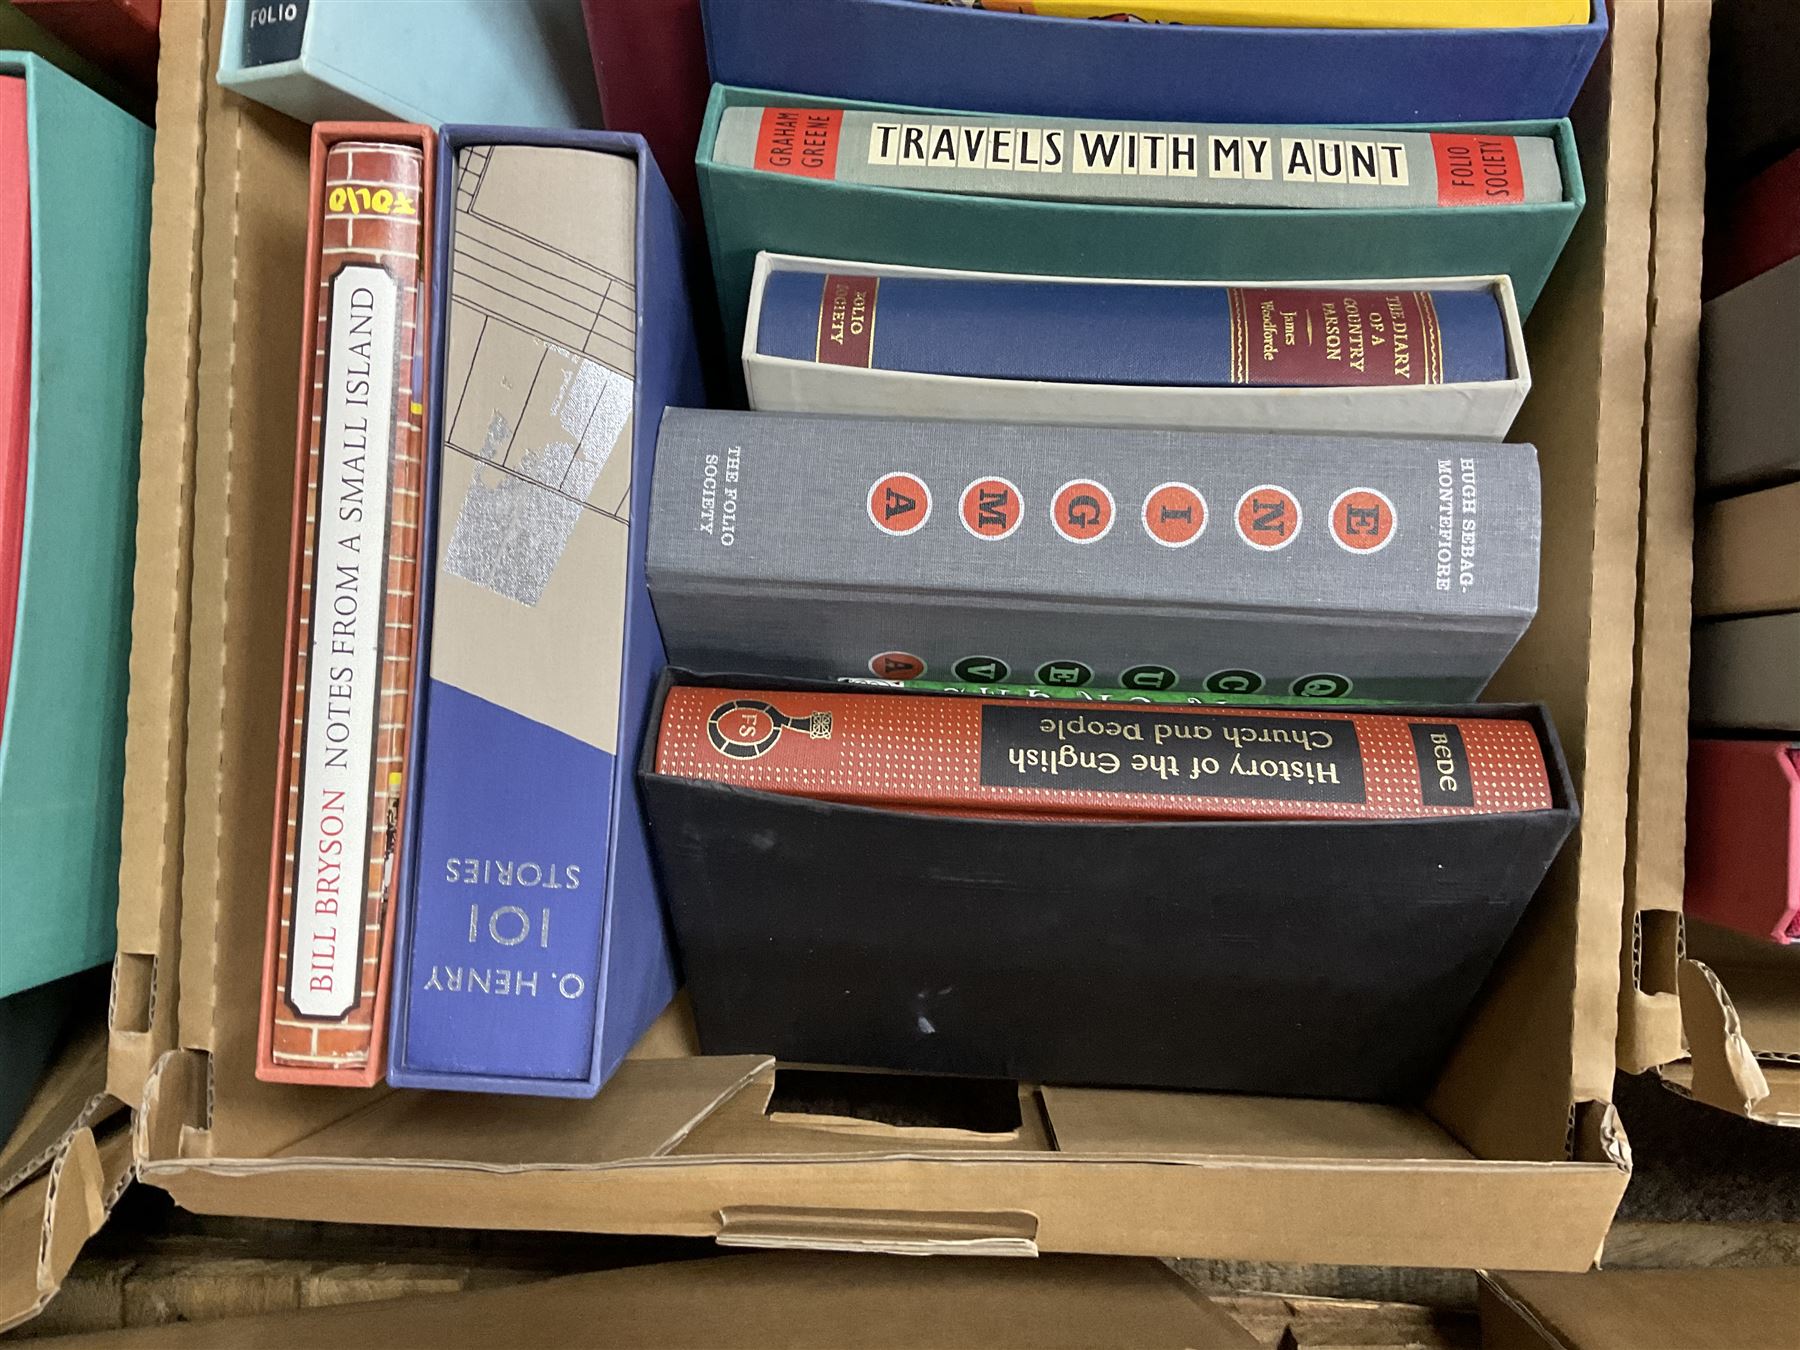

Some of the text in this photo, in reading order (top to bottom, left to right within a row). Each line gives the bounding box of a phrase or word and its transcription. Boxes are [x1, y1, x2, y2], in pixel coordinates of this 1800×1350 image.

[251, 4, 298, 28] FOLIO
[769, 112, 799, 167] GRAHAM
[801, 115, 830, 168] GREENE
[876, 126, 1403, 178] TRAVELS WITH MY AUNT
[1447, 146, 1475, 187] FOLIO
[1478, 141, 1510, 197] SOCIETY
[329, 187, 416, 215] FOLIO
[1260, 300, 1279, 362] Woodforde
[1279, 310, 1297, 346] James
[1322, 302, 1342, 362] PARSON
[1343, 297, 1365, 373] COUNTRY
[1369, 312, 1386, 347] OF A
[1386, 296, 1411, 379] THE DIARY
[700, 454, 719, 536] SOCIETY
[720, 446, 741, 547] THE FOLIO
[1436, 458, 1452, 592] MONTEFIORE
[1460, 457, 1477, 594] HUGH SEBAG-
[309, 286, 375, 993] BILL BRYSON NOTES FROM A SMALL ISLAND
[1154, 723, 1213, 745] and
[1223, 726, 1334, 751] Church
[1008, 744, 1341, 785] History of the English
[445, 856, 582, 890] STORIES
[423, 964, 586, 1000] O. HENRY
